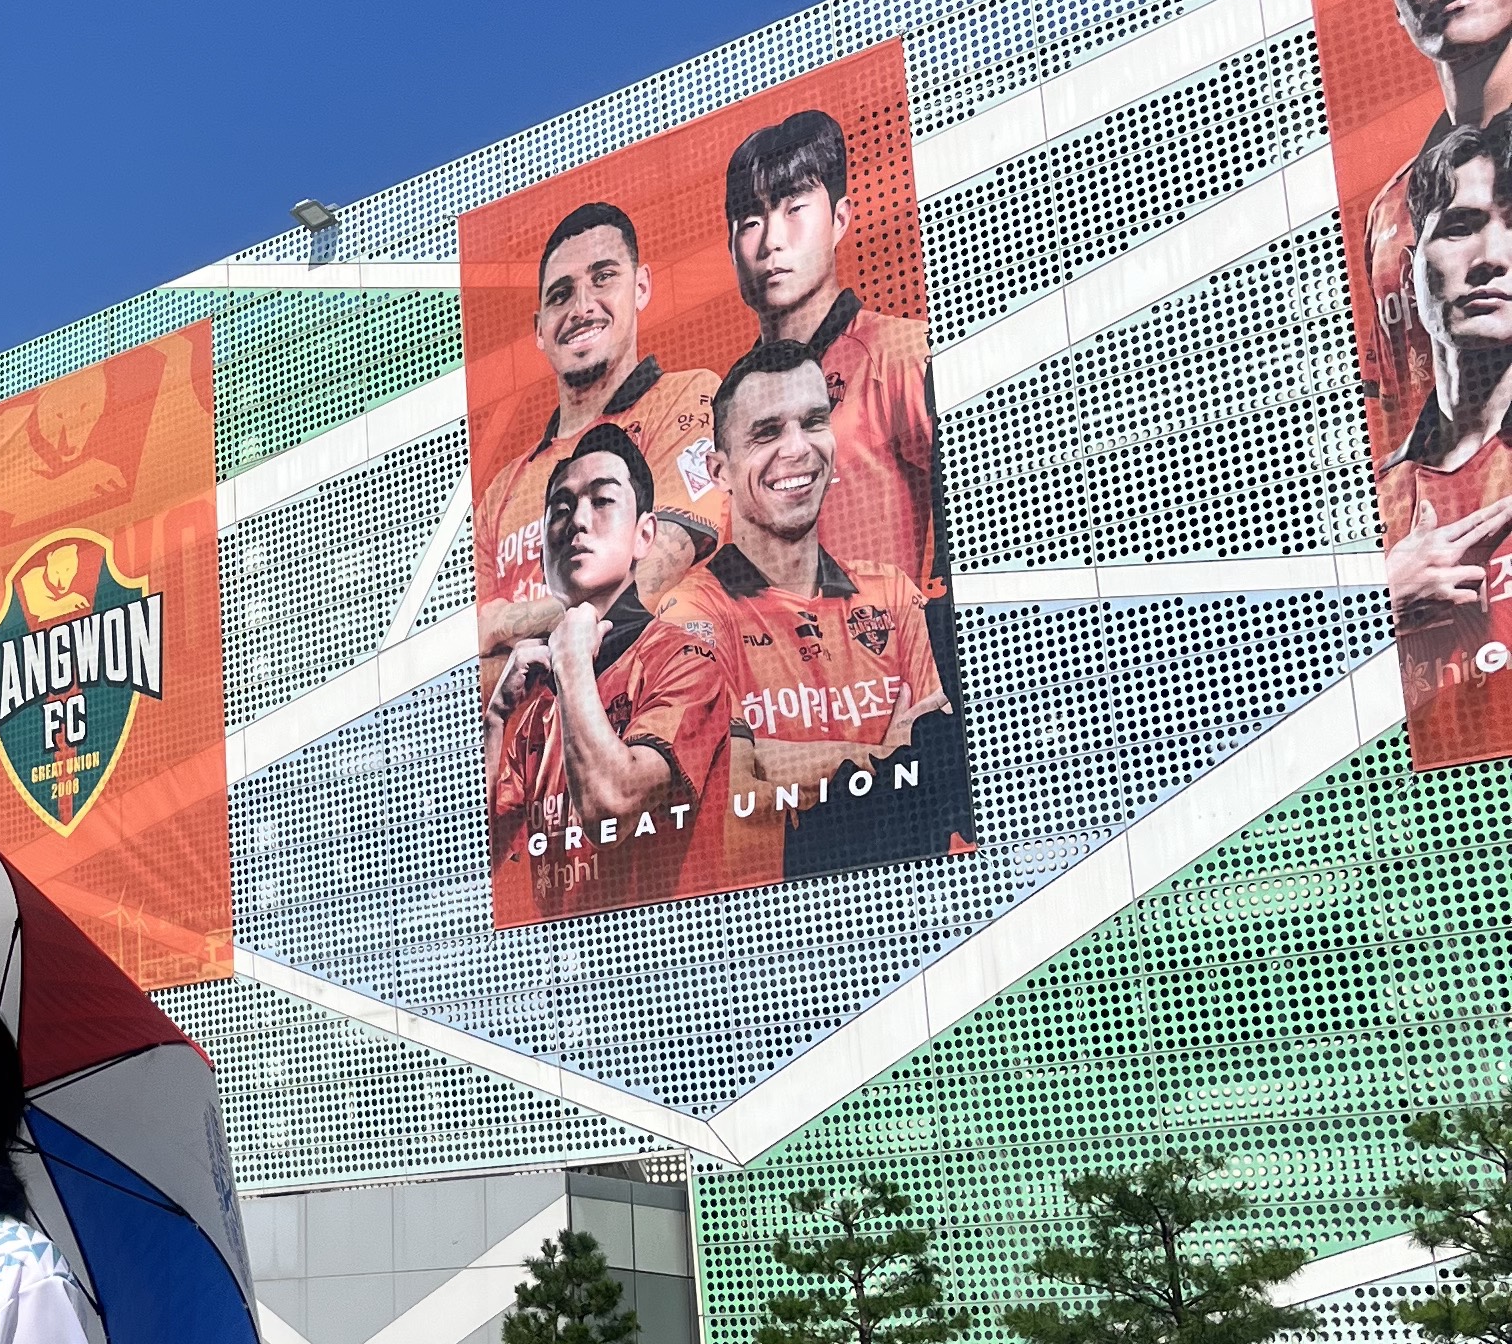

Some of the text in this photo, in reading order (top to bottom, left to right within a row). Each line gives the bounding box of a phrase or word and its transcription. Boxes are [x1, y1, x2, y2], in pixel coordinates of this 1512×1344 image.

[683, 644, 717, 663] FILA
[742, 633, 774, 647] FILA
[43, 693, 86, 750] FC
[31, 751, 101, 784] GREAT UNION
[51, 777, 80, 800] 2008
[527, 760, 920, 857] GREAT UNION
